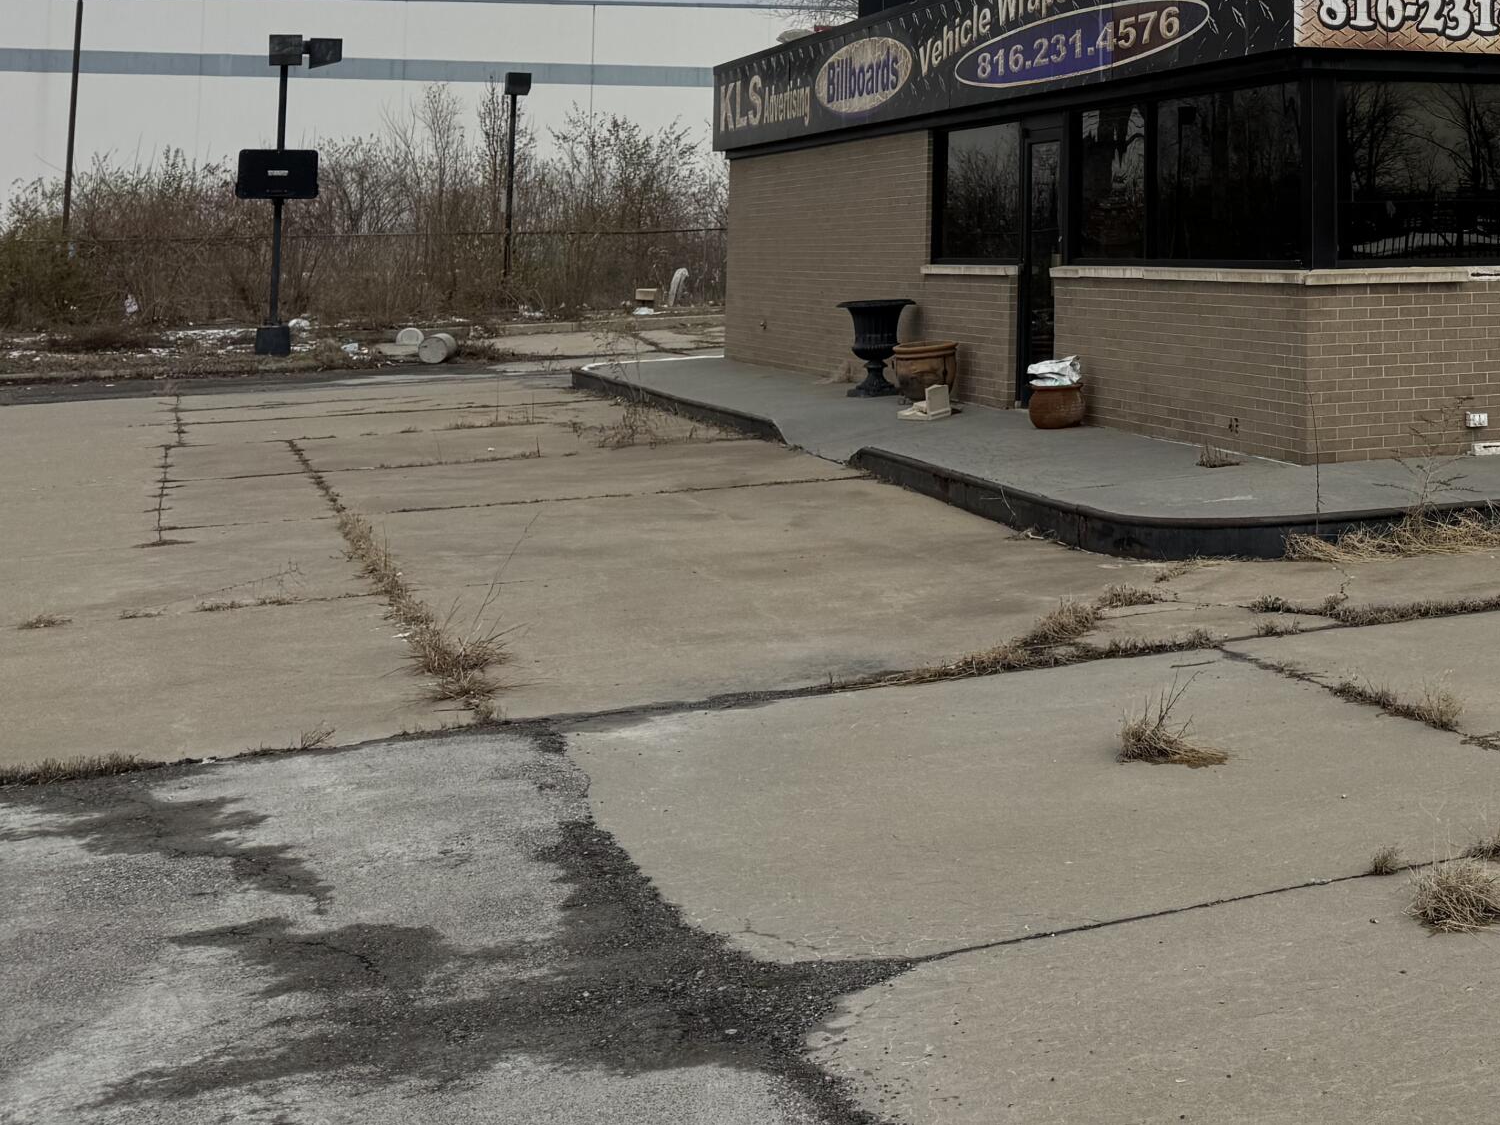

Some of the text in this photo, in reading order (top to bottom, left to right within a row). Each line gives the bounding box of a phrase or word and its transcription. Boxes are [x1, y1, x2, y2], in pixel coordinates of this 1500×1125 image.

[918, 7, 991, 76] Vehicle
[977, 6, 1181, 79] 816.231.4576
[720, 75, 811, 133] KLS Advertising
[827, 47, 900, 104] Billboards
